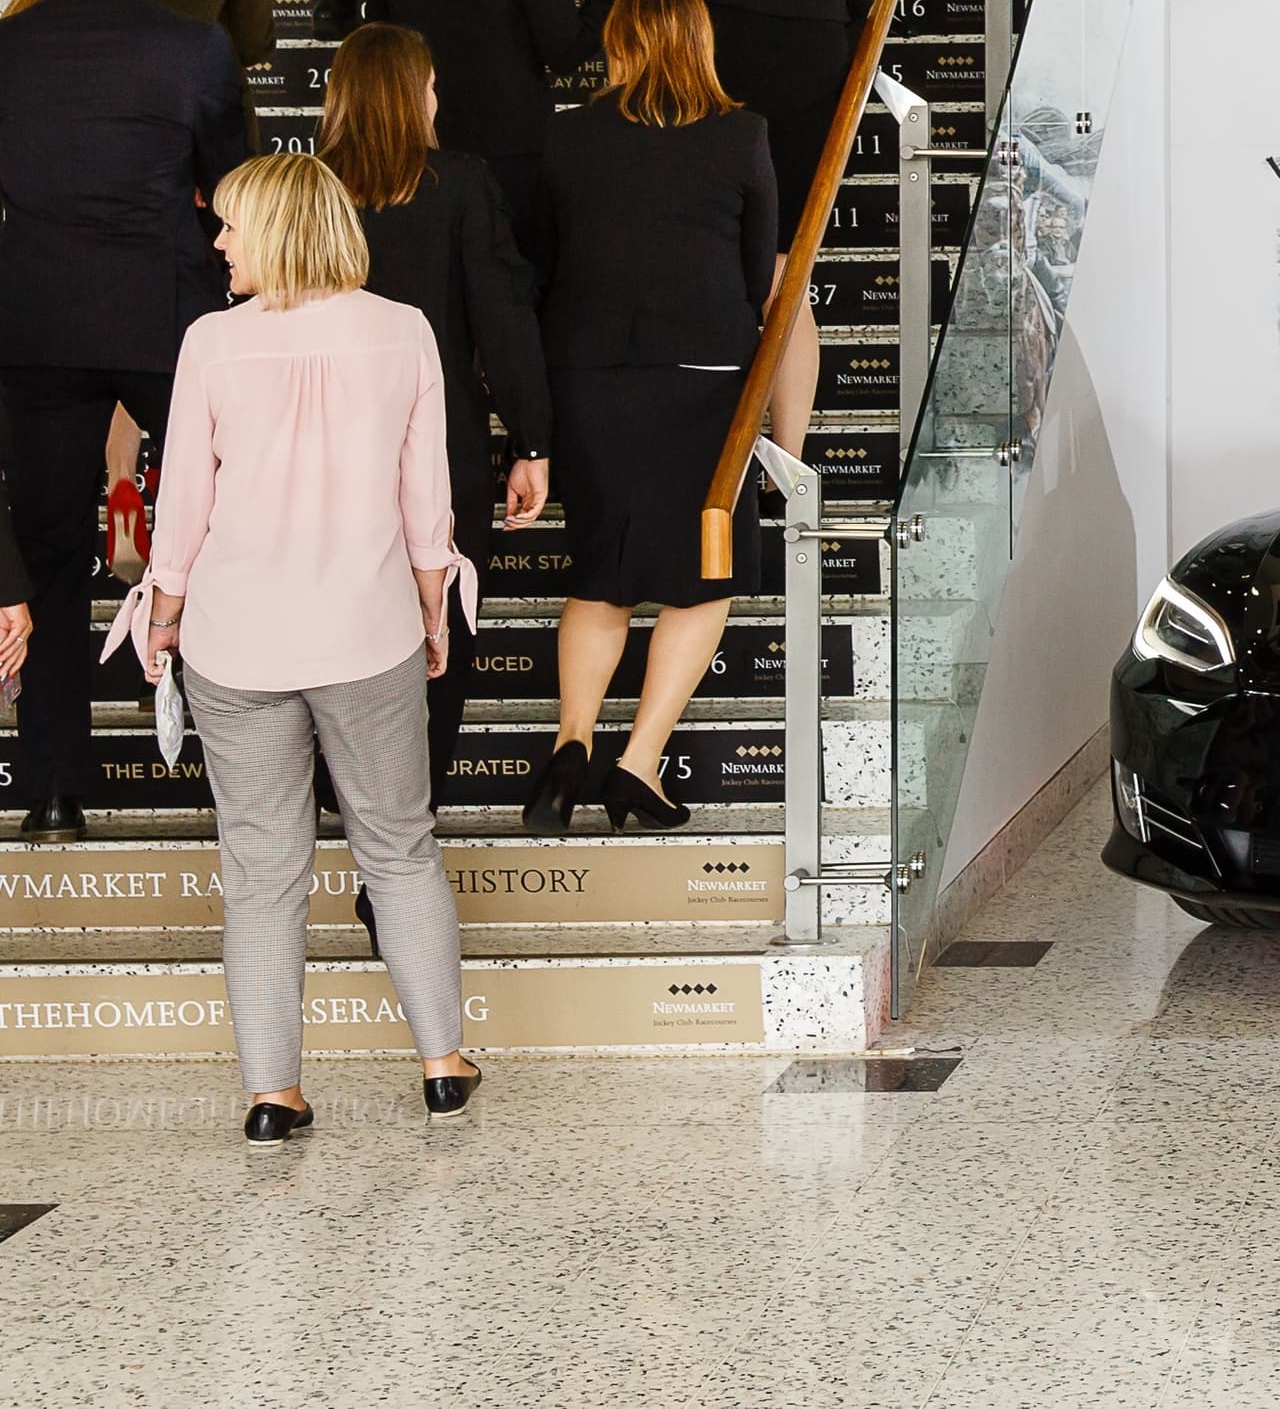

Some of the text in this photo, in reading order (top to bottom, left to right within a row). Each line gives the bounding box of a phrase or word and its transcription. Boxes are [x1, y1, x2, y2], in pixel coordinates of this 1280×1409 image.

[102, 763, 145, 780] THE
[721, 762, 785, 776] NEWMARK
[687, 879, 767, 892] NEWMARKET
[653, 1001, 736, 1015] NEWMARKET
